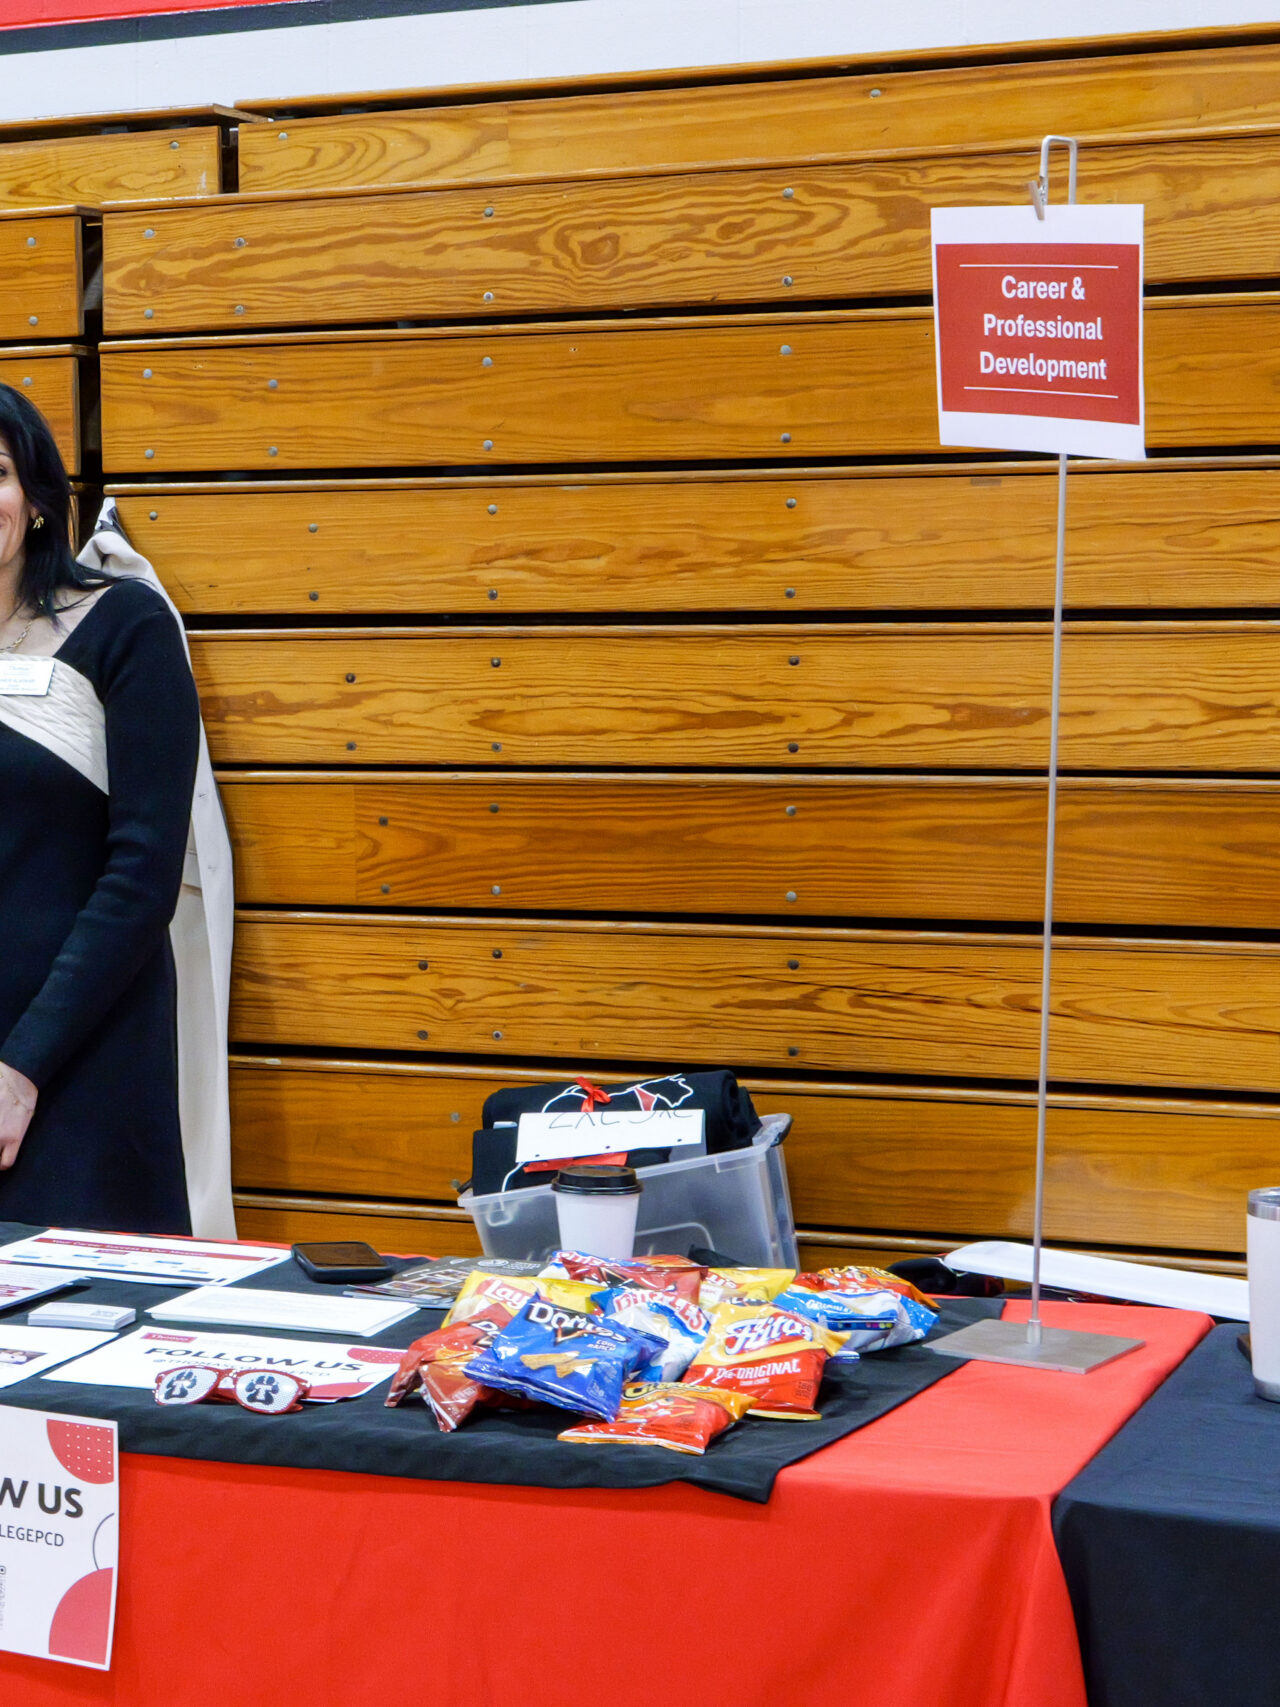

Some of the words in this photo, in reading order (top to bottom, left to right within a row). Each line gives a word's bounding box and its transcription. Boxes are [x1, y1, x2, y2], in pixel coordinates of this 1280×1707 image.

[1001, 275, 1068, 299] Career
[1071, 276, 1086, 300] &
[983, 313, 1103, 340] Professional
[979, 351, 1107, 382] Development
[485, 1279, 530, 1310] Lay
[725, 1316, 814, 1356] Fritos
[144, 1347, 310, 1367] FOLLOW
[314, 1360, 365, 1371] US
[37, 1482, 84, 1518] US
